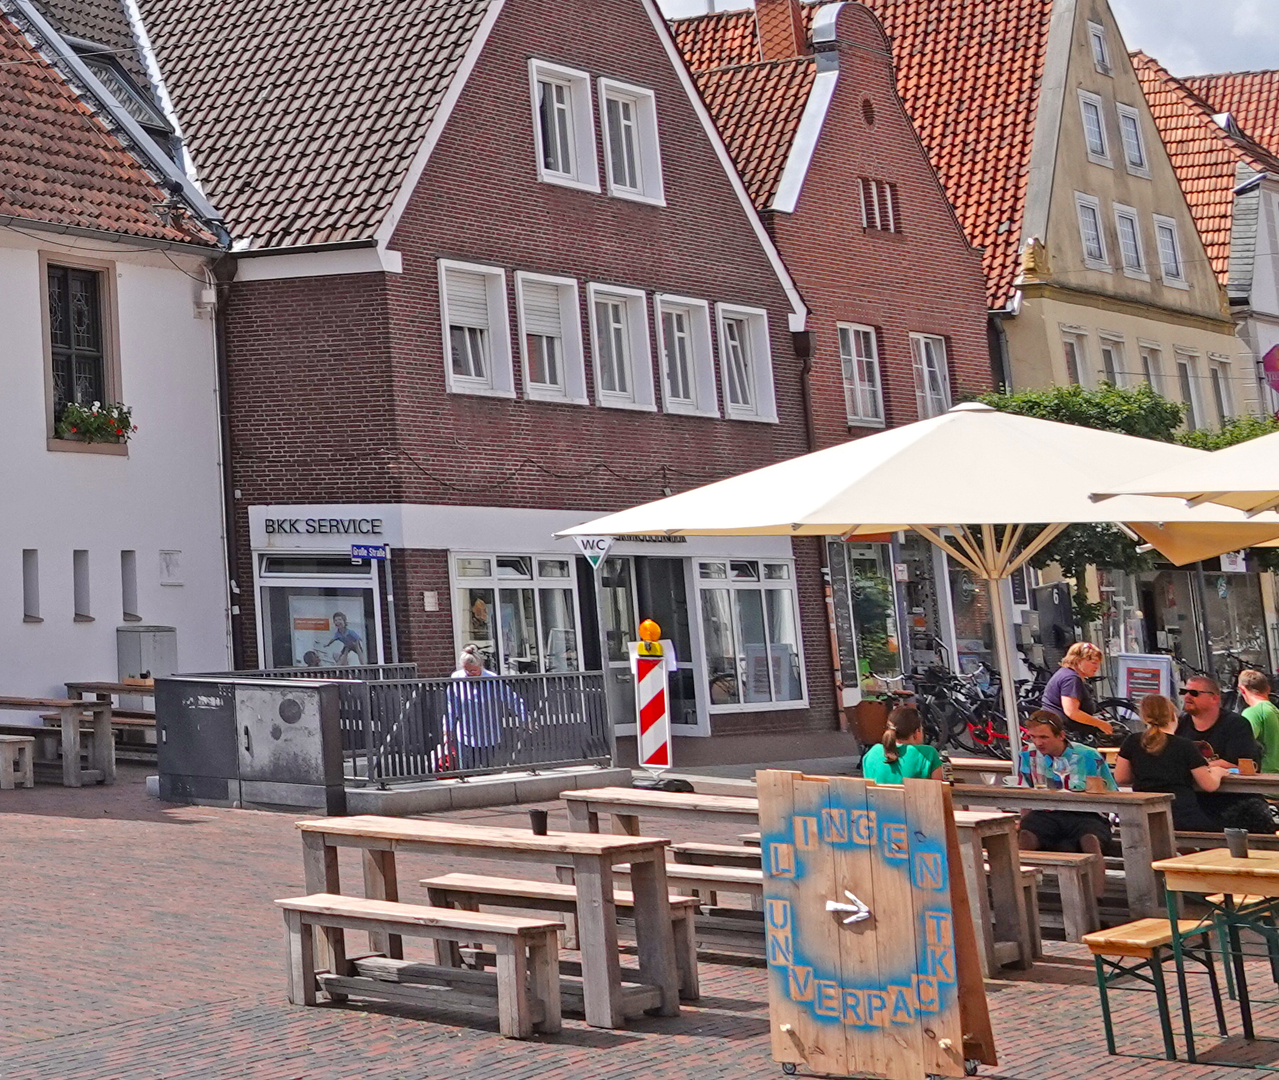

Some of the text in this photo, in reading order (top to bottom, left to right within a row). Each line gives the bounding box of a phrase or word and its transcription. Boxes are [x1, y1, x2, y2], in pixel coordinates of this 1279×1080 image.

[265, 518, 383, 535] BKK SERVICE
[581, 539, 606, 551] WC
[1053, 588, 1060, 605] 6
[773, 809, 942, 886] LINGEN
[769, 900, 953, 1024] UNVERPACKT
